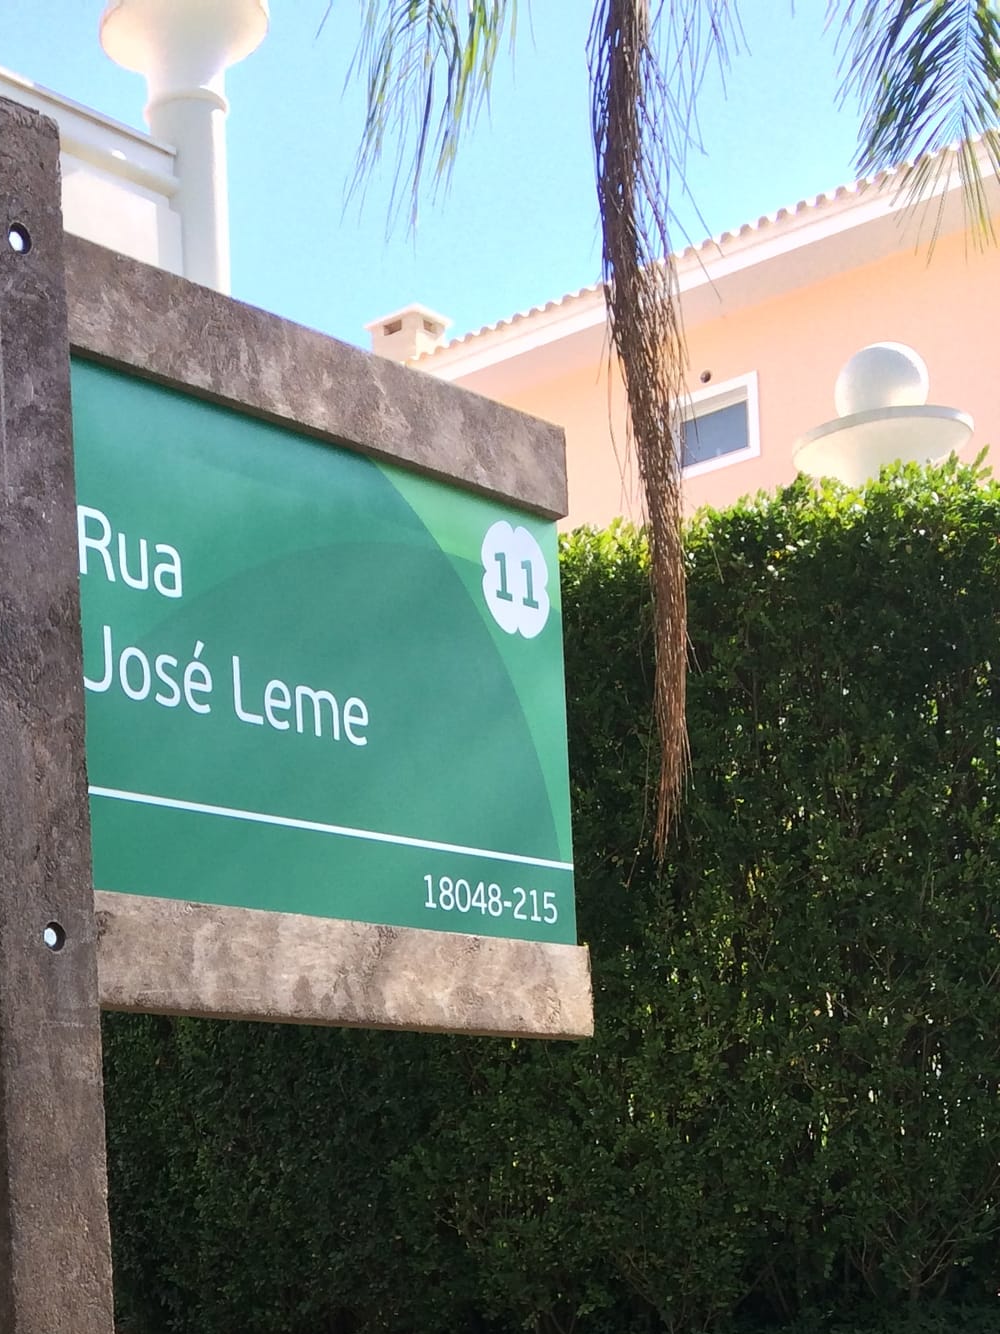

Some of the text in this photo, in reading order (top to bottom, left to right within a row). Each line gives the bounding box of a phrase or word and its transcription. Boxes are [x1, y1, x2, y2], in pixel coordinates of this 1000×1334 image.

[77, 505, 182, 597] Rua
[494, 552, 540, 609] 11
[83, 625, 369, 746] José Leme
[423, 874, 558, 924] 18048-215
